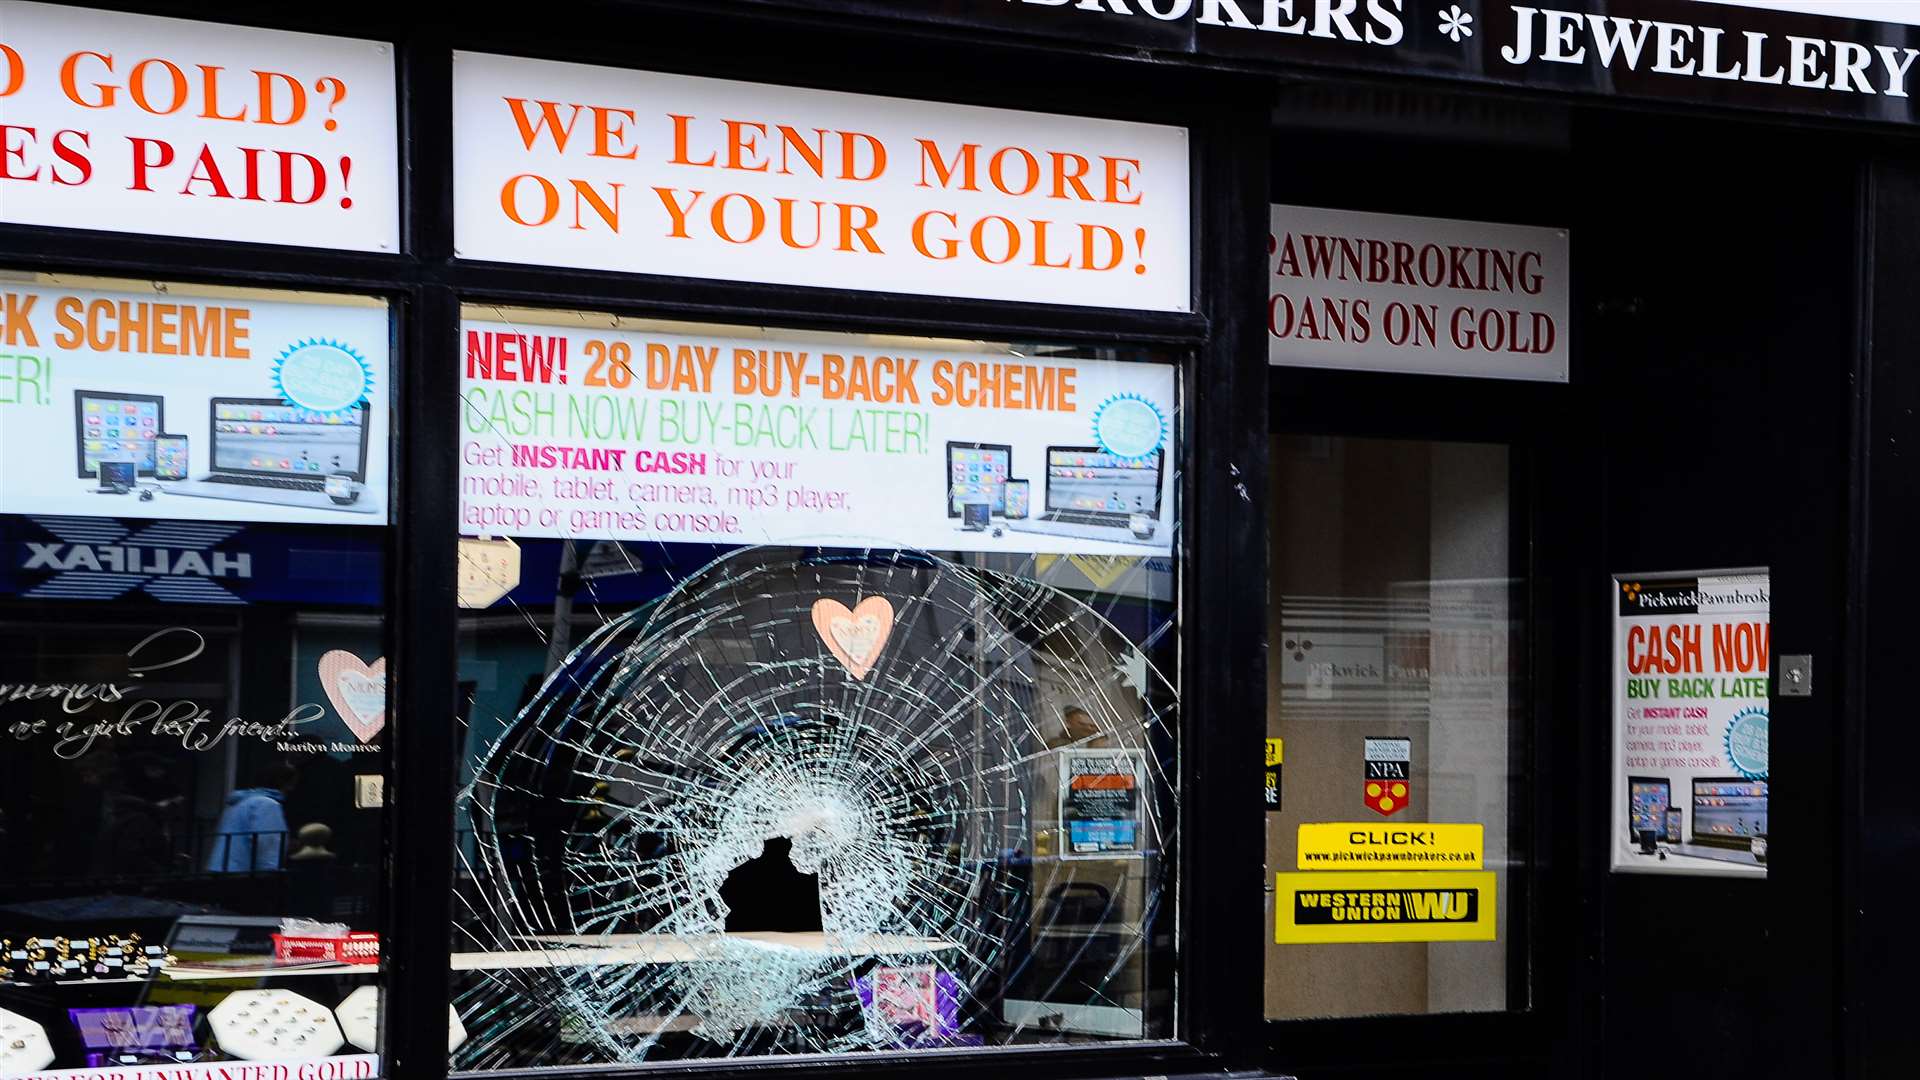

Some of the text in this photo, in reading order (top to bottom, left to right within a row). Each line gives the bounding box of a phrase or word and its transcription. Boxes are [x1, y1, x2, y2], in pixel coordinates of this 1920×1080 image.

[1501, 5, 1919, 98] JEWELLERY
[60, 50, 347, 132] GOLD?
[502, 96, 1143, 206] WE LEND MORE
[125, 136, 353, 210] PAID!
[500, 174, 1147, 276] ON YOUR GOLD!
[55, 296, 252, 360] SCHEME
[1382, 302, 1440, 349] ON
[1450, 306, 1556, 355] GOLD
[466, 330, 1077, 413] NEW! 28 DAY BUY-BACK SCHEME
[464, 386, 930, 455] CASH NOW BUY-BACK LATER!
[463, 441, 798, 482] Get INSTANT CASH for your
[463, 475, 852, 514] mobile, tablet, camera, mp3 player,
[462, 502, 743, 535] laptop or games console.
[1639, 590, 1700, 607] Pickwick
[1628, 624, 1703, 674] CASH
[1628, 677, 1768, 698] BUY BACK LATE
[1643, 707, 1680, 718] INSTANT
[277, 741, 382, 753] Marilyn Monroe
[1370, 762, 1404, 777] NPA
[1349, 831, 1435, 845] CLICK!
[1300, 891, 1469, 920] WESTERN WU
[1332, 907, 1401, 921] UNION
